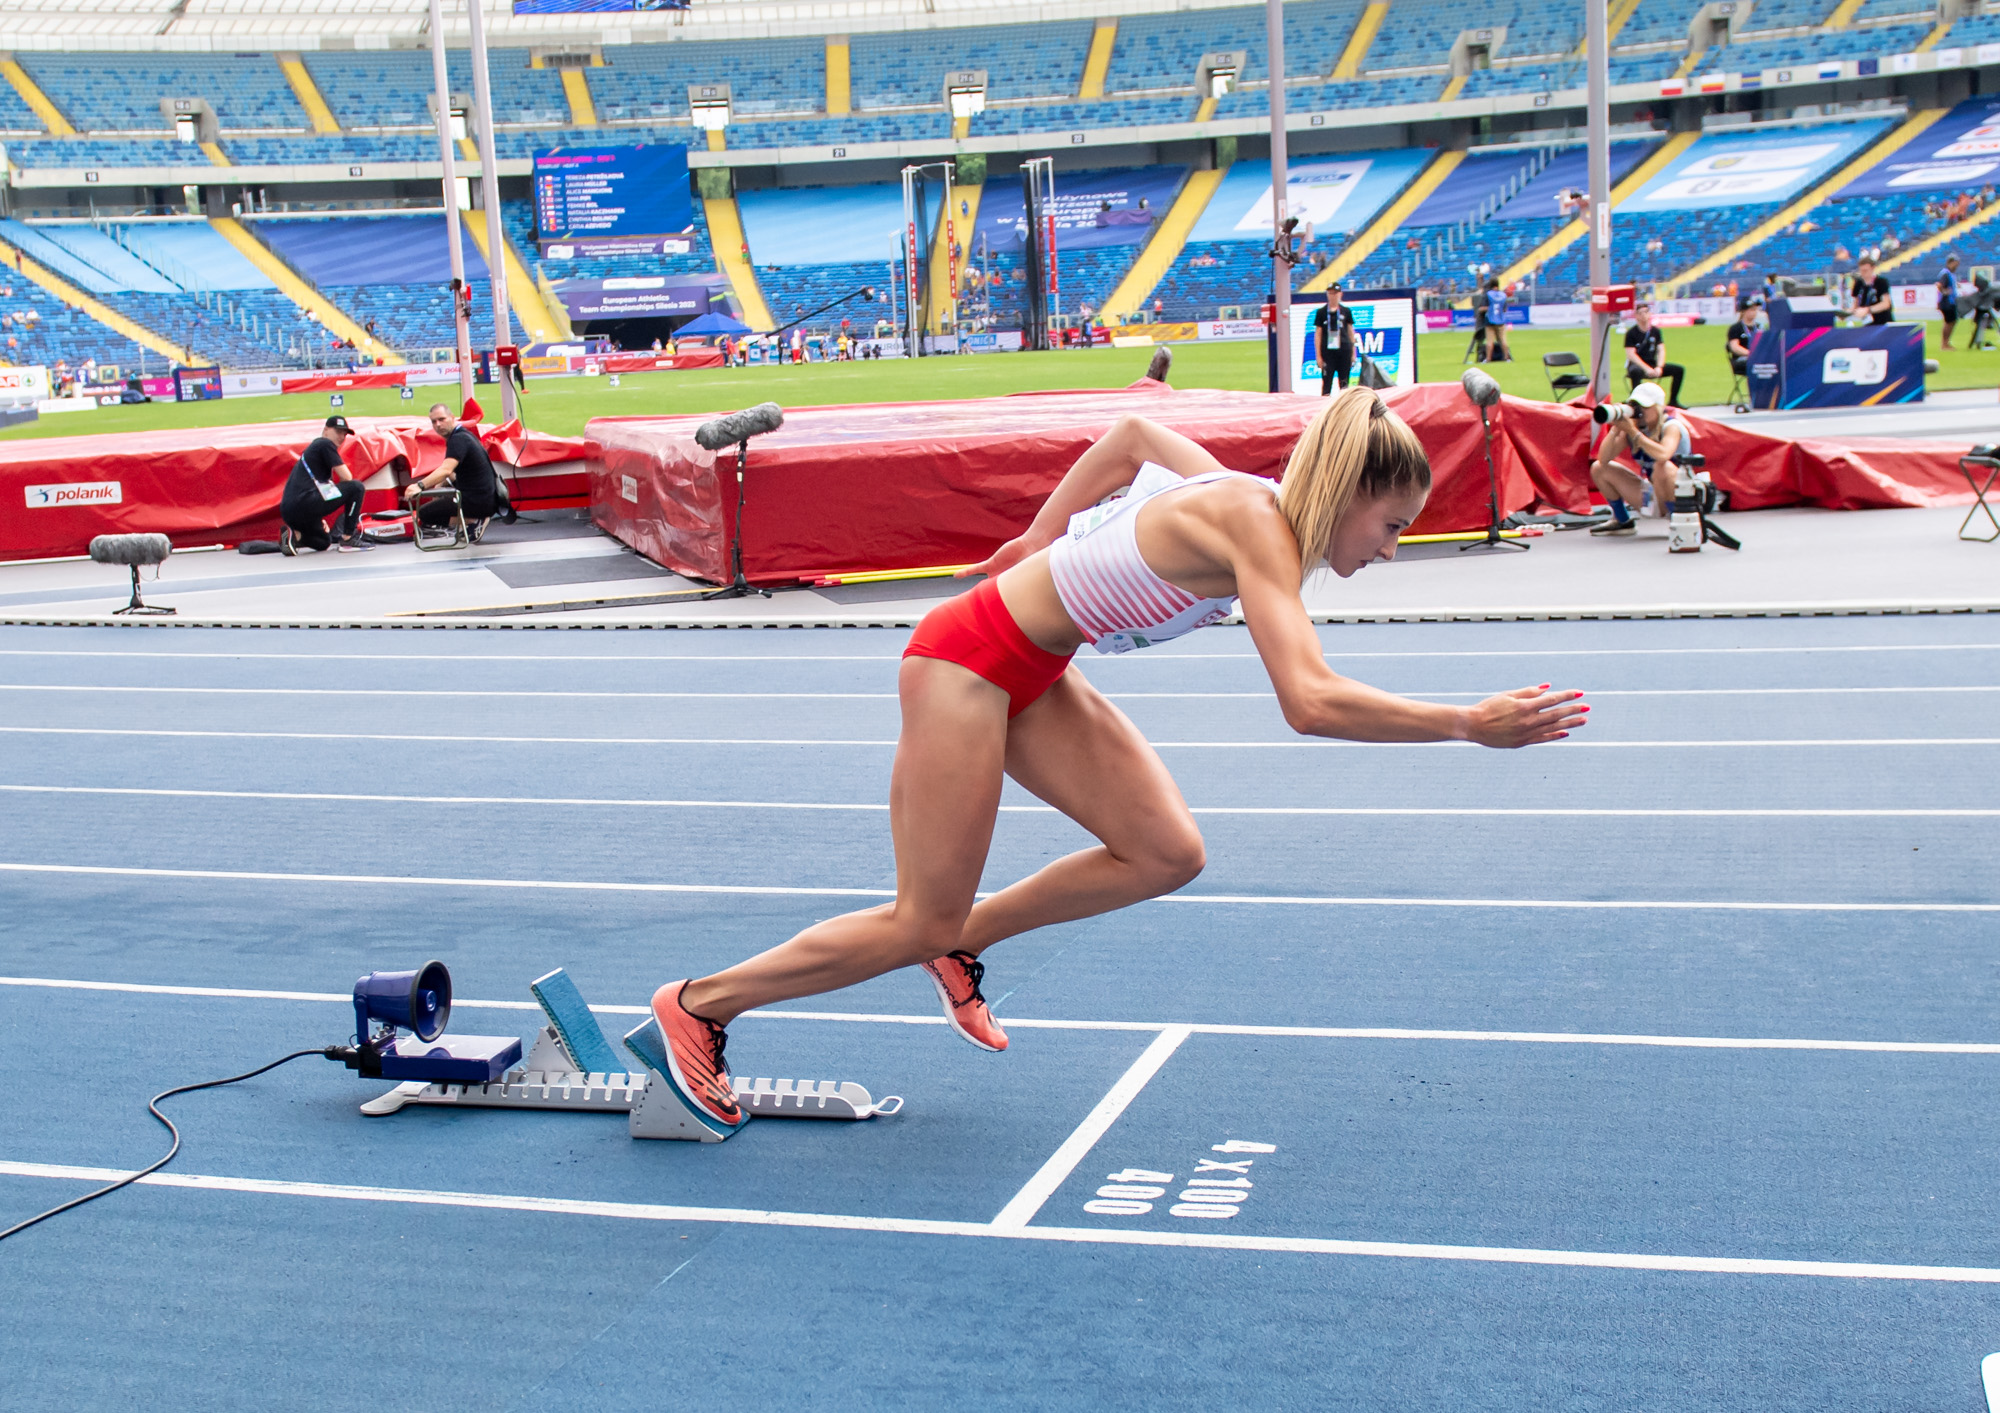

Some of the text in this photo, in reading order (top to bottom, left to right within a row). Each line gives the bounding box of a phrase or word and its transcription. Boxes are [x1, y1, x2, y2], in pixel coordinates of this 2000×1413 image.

[834, 148, 845, 158] 21
[603, 294, 669, 305] European Athletics
[600, 303, 655, 312] Championships
[655, 302, 678, 310] Silesia
[679, 300, 696, 308] 2023
[56, 485, 114, 503] polanik
[1083, 1168, 1174, 1215] 400
